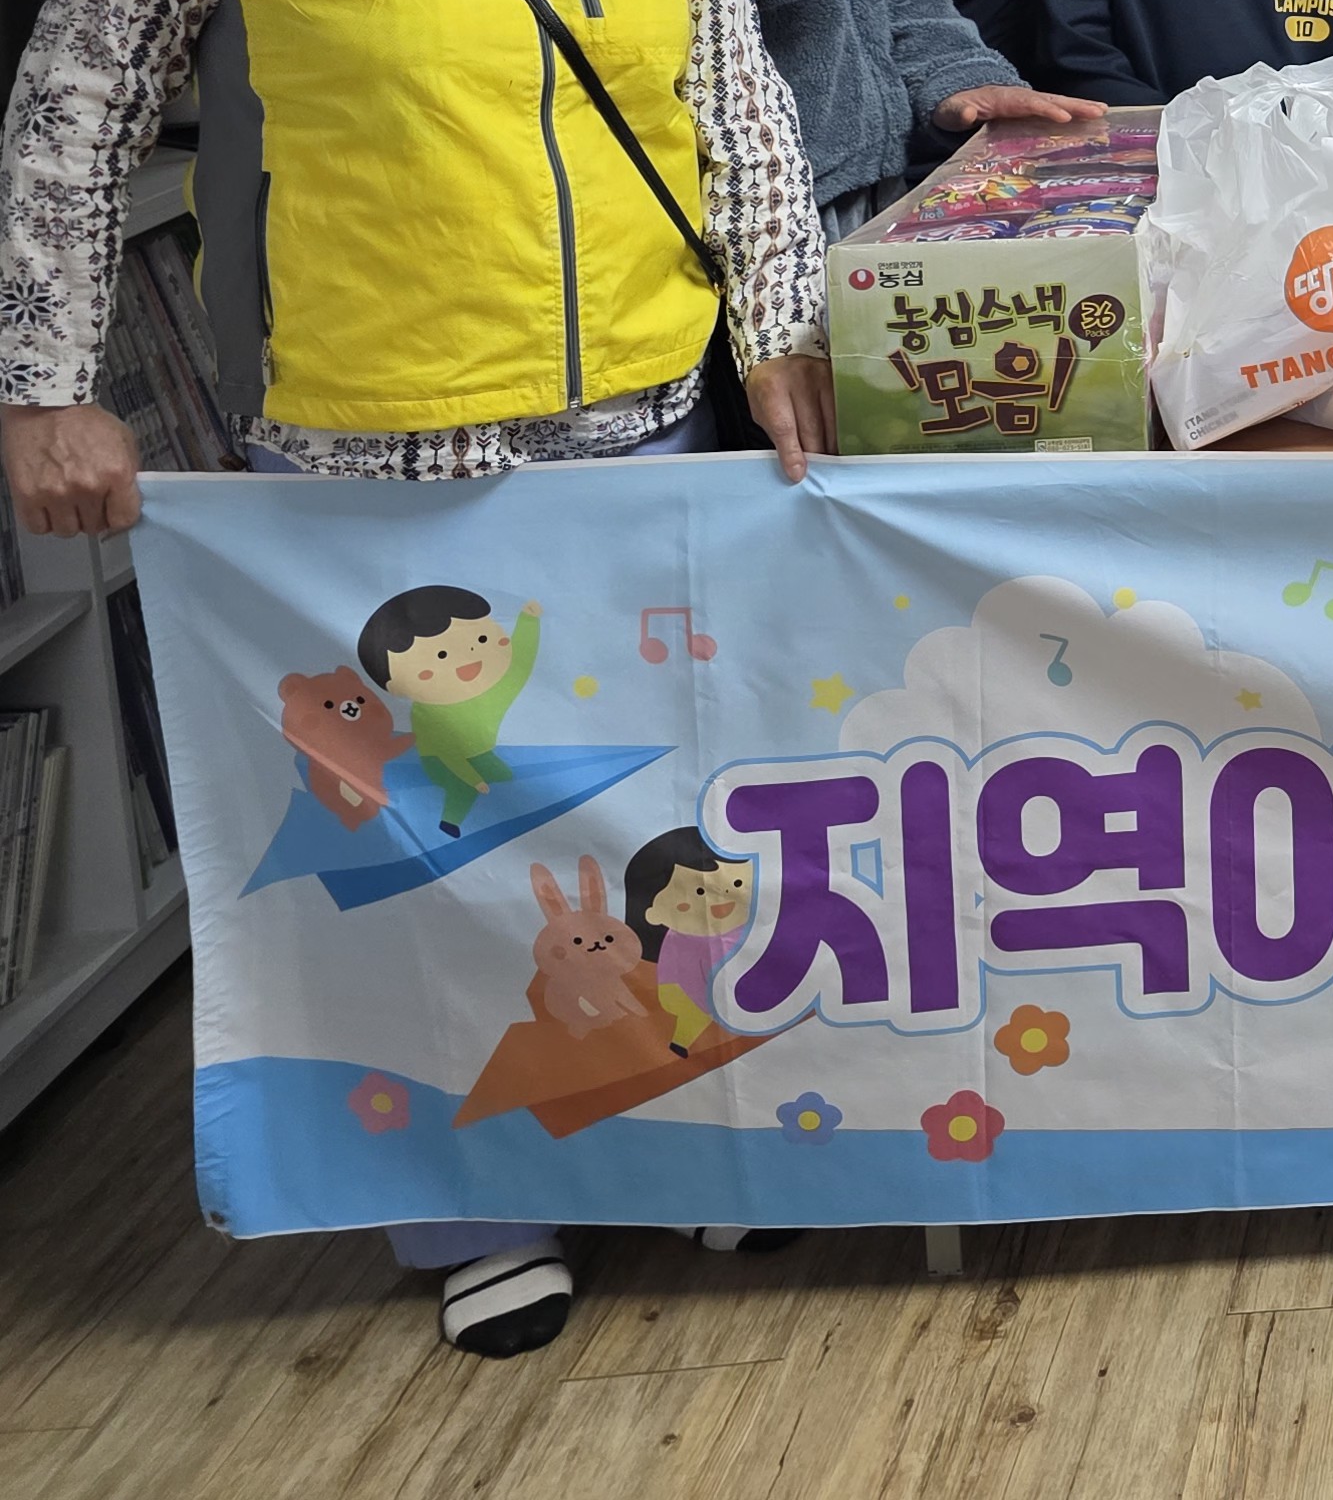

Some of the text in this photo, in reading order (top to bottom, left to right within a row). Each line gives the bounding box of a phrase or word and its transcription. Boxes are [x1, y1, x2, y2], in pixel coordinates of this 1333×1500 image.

[1294, 20, 1313, 38] 10
[877, 270, 924, 289] 농심
[886, 283, 1117, 351] 농심스낵 36
[1085, 328, 1111, 338] Packs
